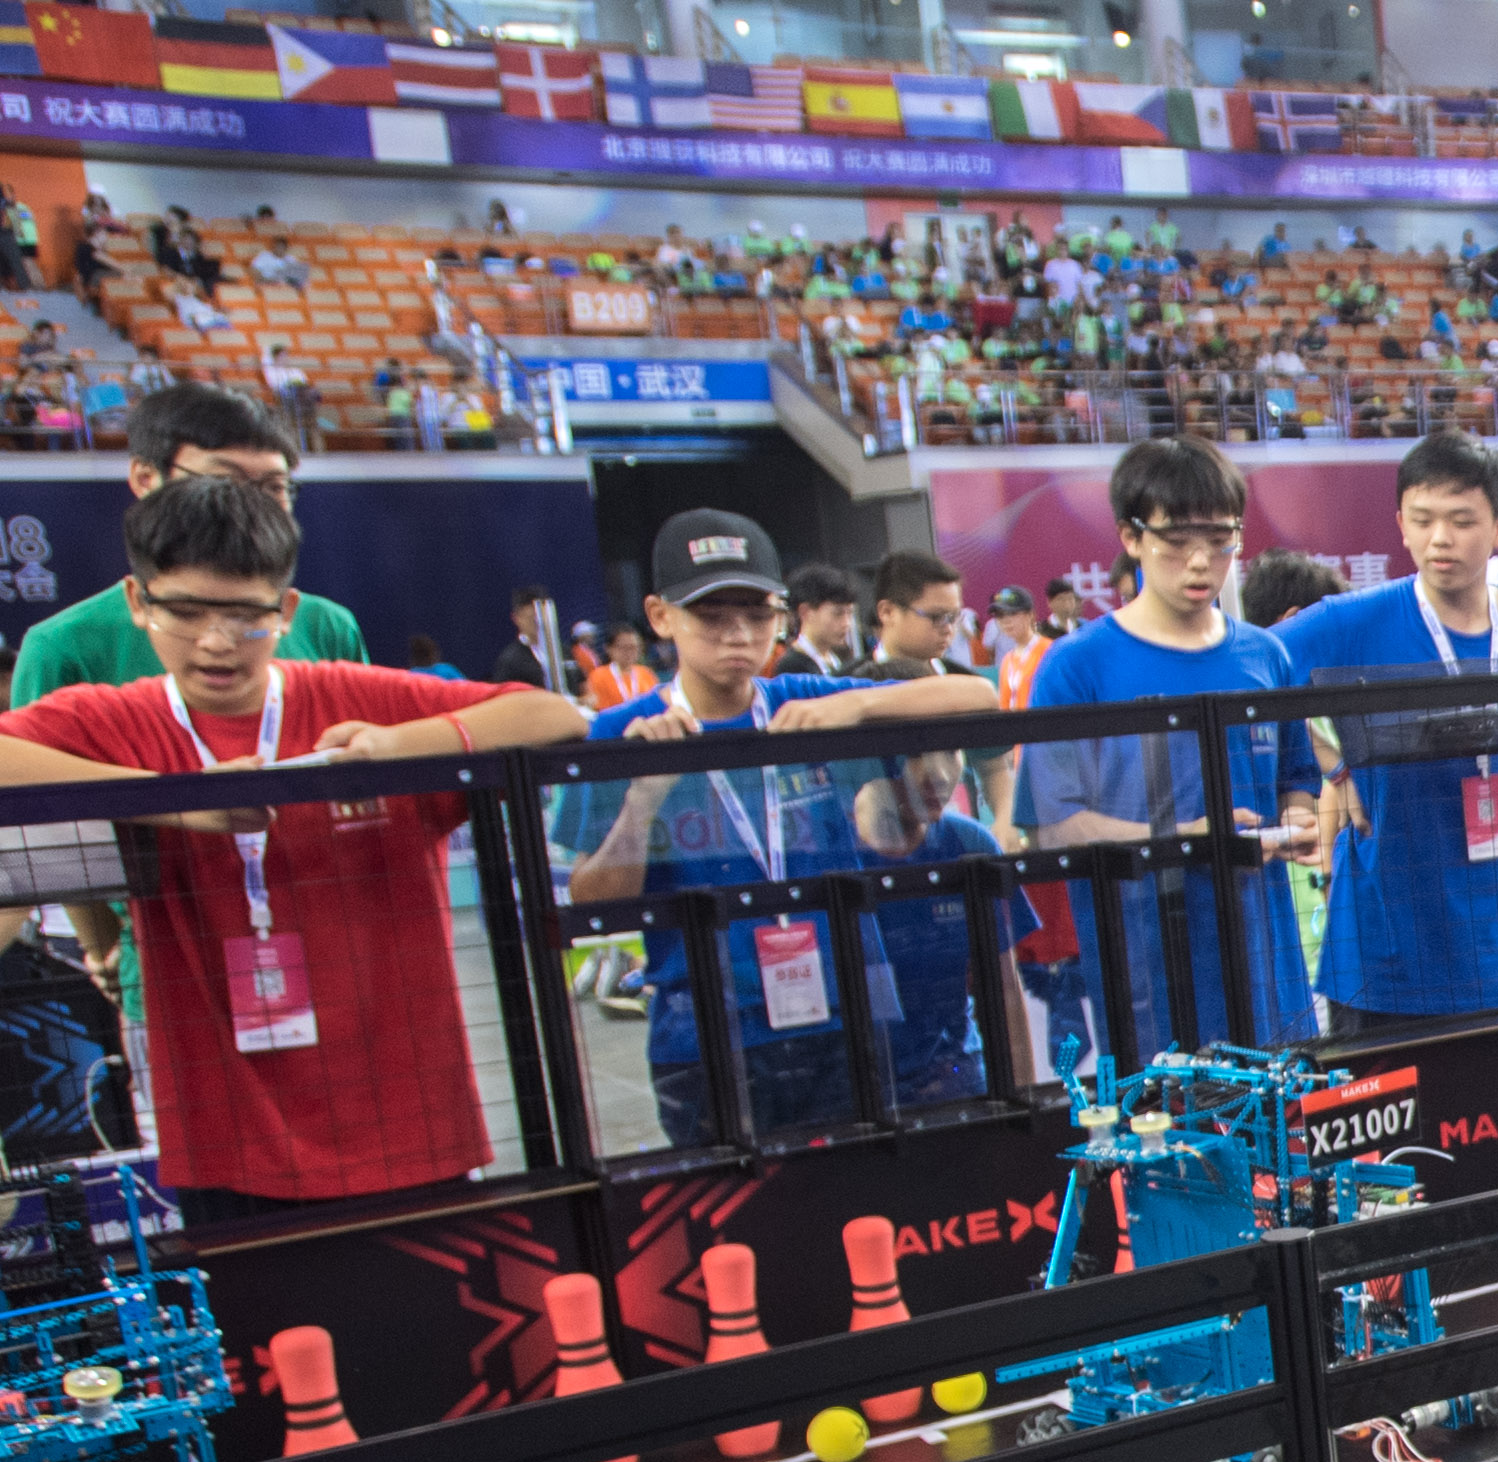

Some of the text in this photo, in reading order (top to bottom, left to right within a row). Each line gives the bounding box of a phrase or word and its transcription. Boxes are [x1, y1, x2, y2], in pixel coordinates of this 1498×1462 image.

[571, 290, 648, 323] B209
[1309, 1098, 1416, 1157] X21007
[894, 1189, 1059, 1261] AKEX
